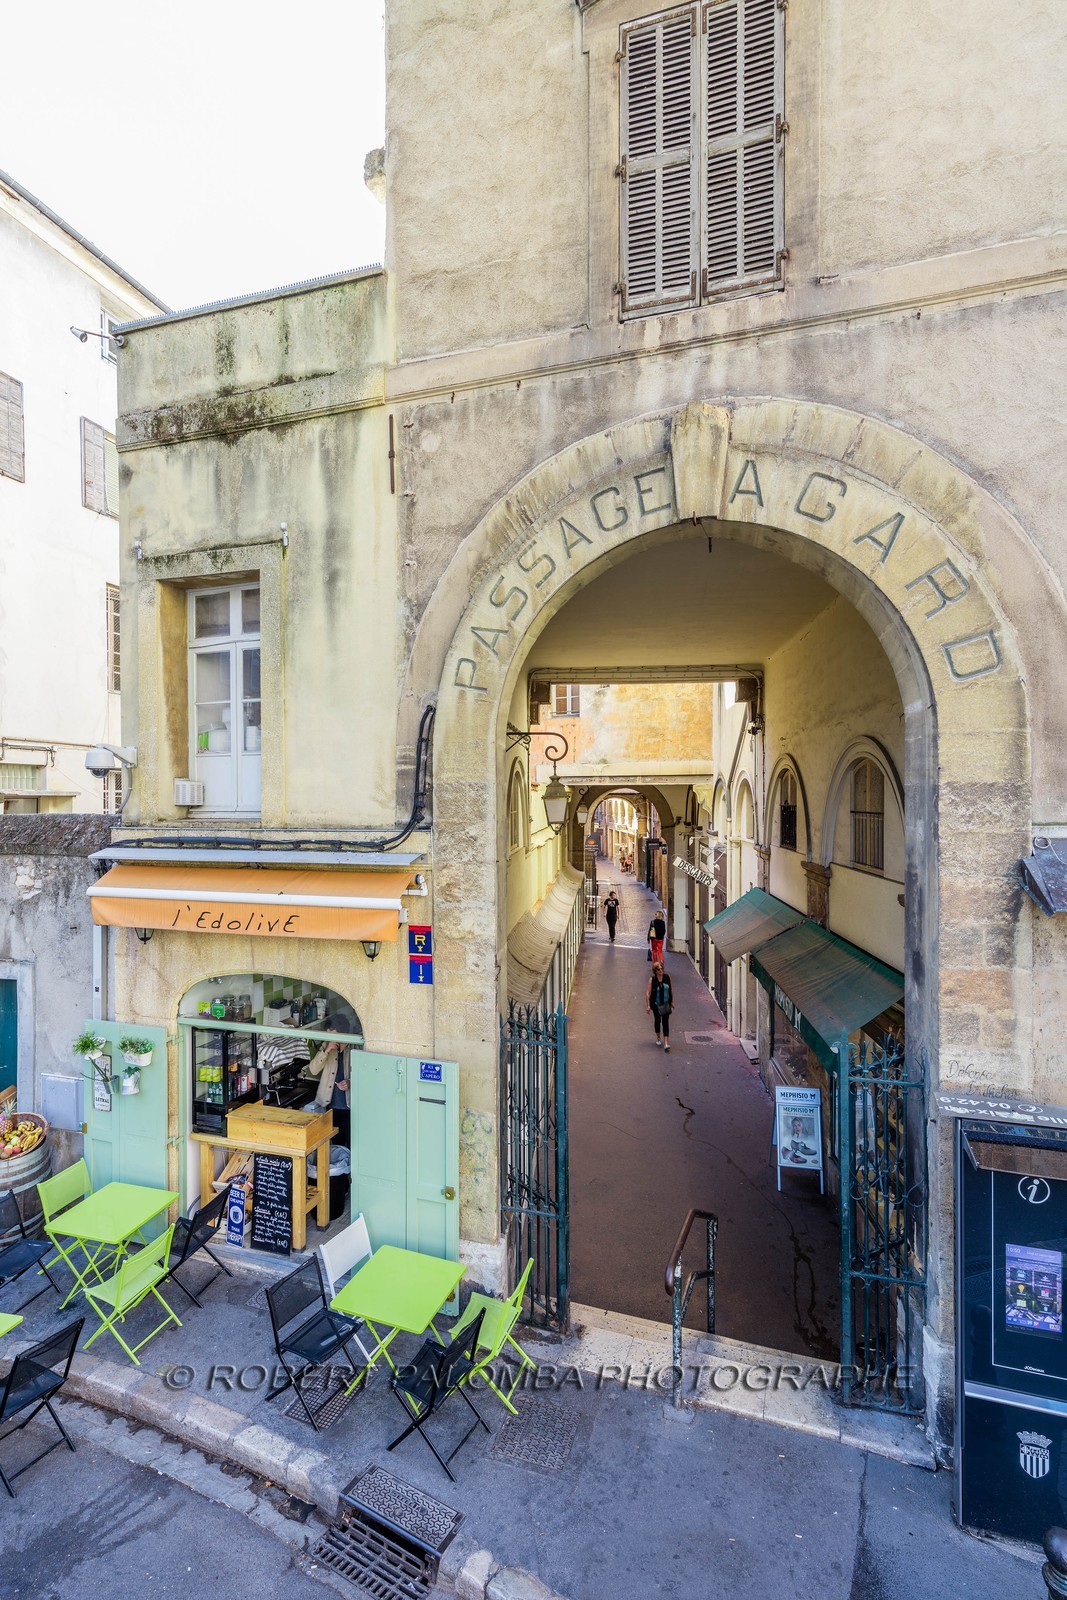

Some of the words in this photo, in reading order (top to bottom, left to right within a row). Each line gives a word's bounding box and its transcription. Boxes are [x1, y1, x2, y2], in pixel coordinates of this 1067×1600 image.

[453, 466, 673, 695] PASSAGE
[796, 471, 1002, 682] GARD
[677, 860, 714, 886] DESCAMPS
[780, 1091, 809, 1100] MEPHISTO
[783, 1106, 809, 1114] MEPHISTO
